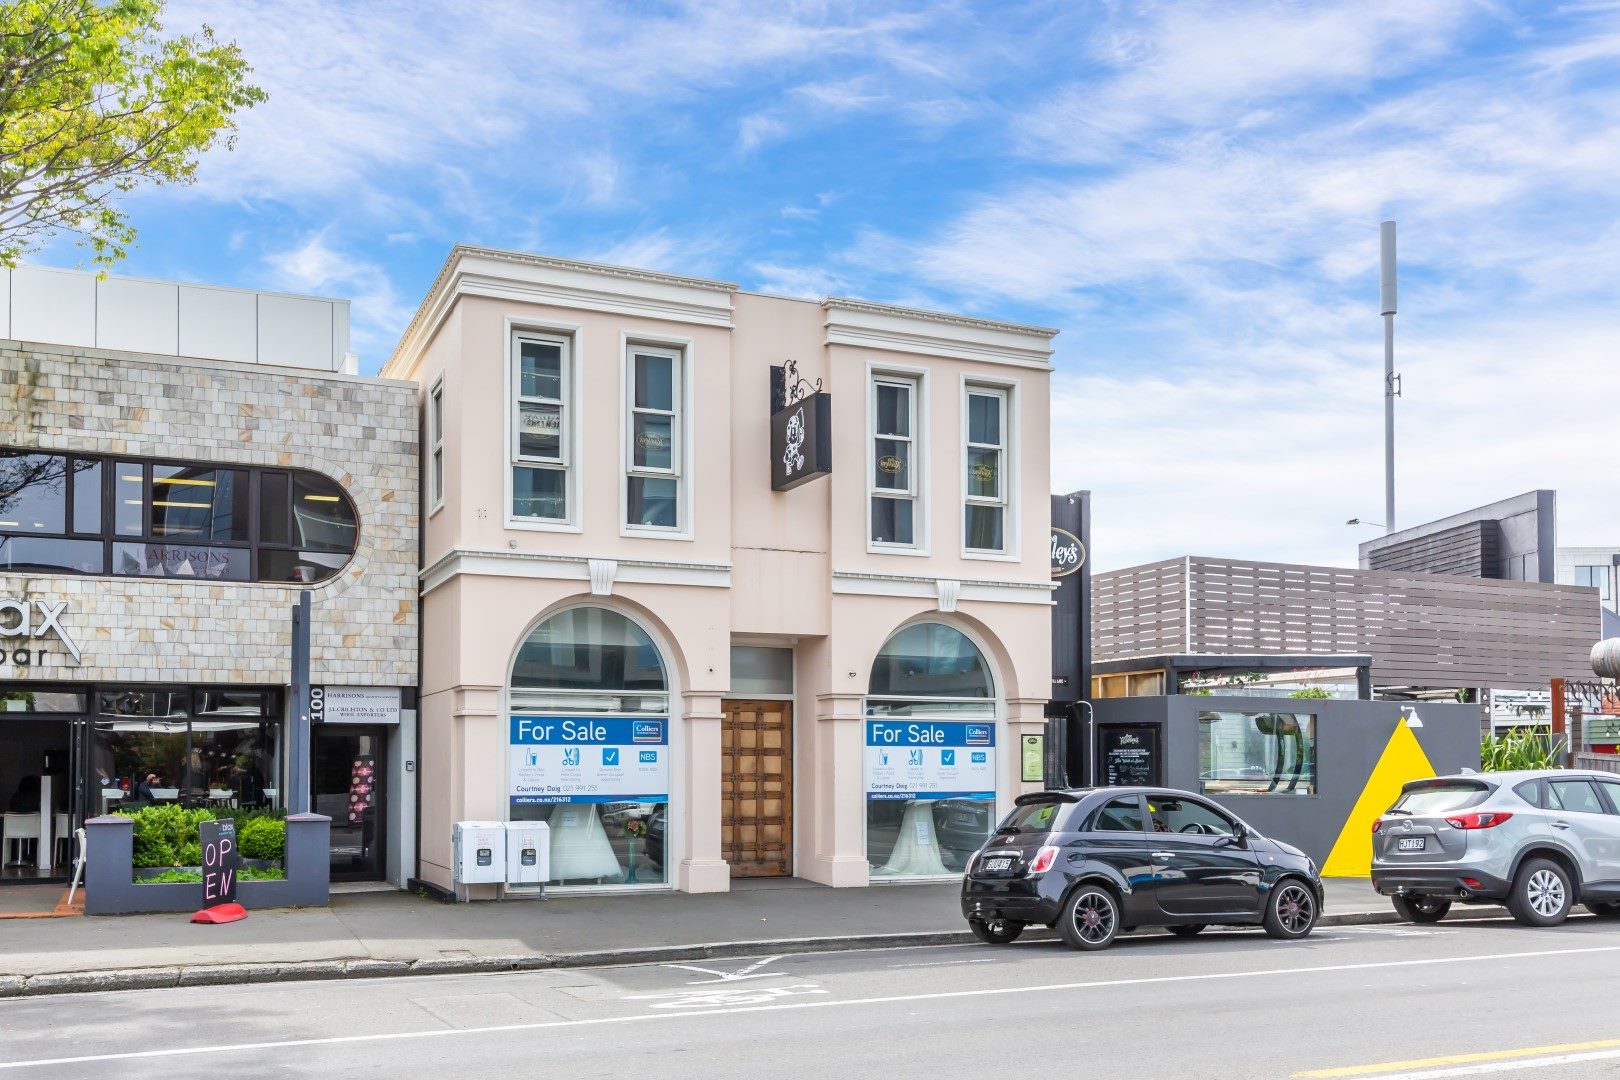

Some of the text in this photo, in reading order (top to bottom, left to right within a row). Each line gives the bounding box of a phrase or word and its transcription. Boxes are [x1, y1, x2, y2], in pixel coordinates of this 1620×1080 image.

[1050, 534, 1078, 565] ley's
[311, 688, 323, 720] 100
[518, 720, 607, 741] For Sale
[873, 723, 945, 743] For Sale
[640, 753, 656, 761] NBS
[972, 753, 985, 761] NBS
[516, 785, 545, 793] Courtney
[546, 785, 561, 793] Doig
